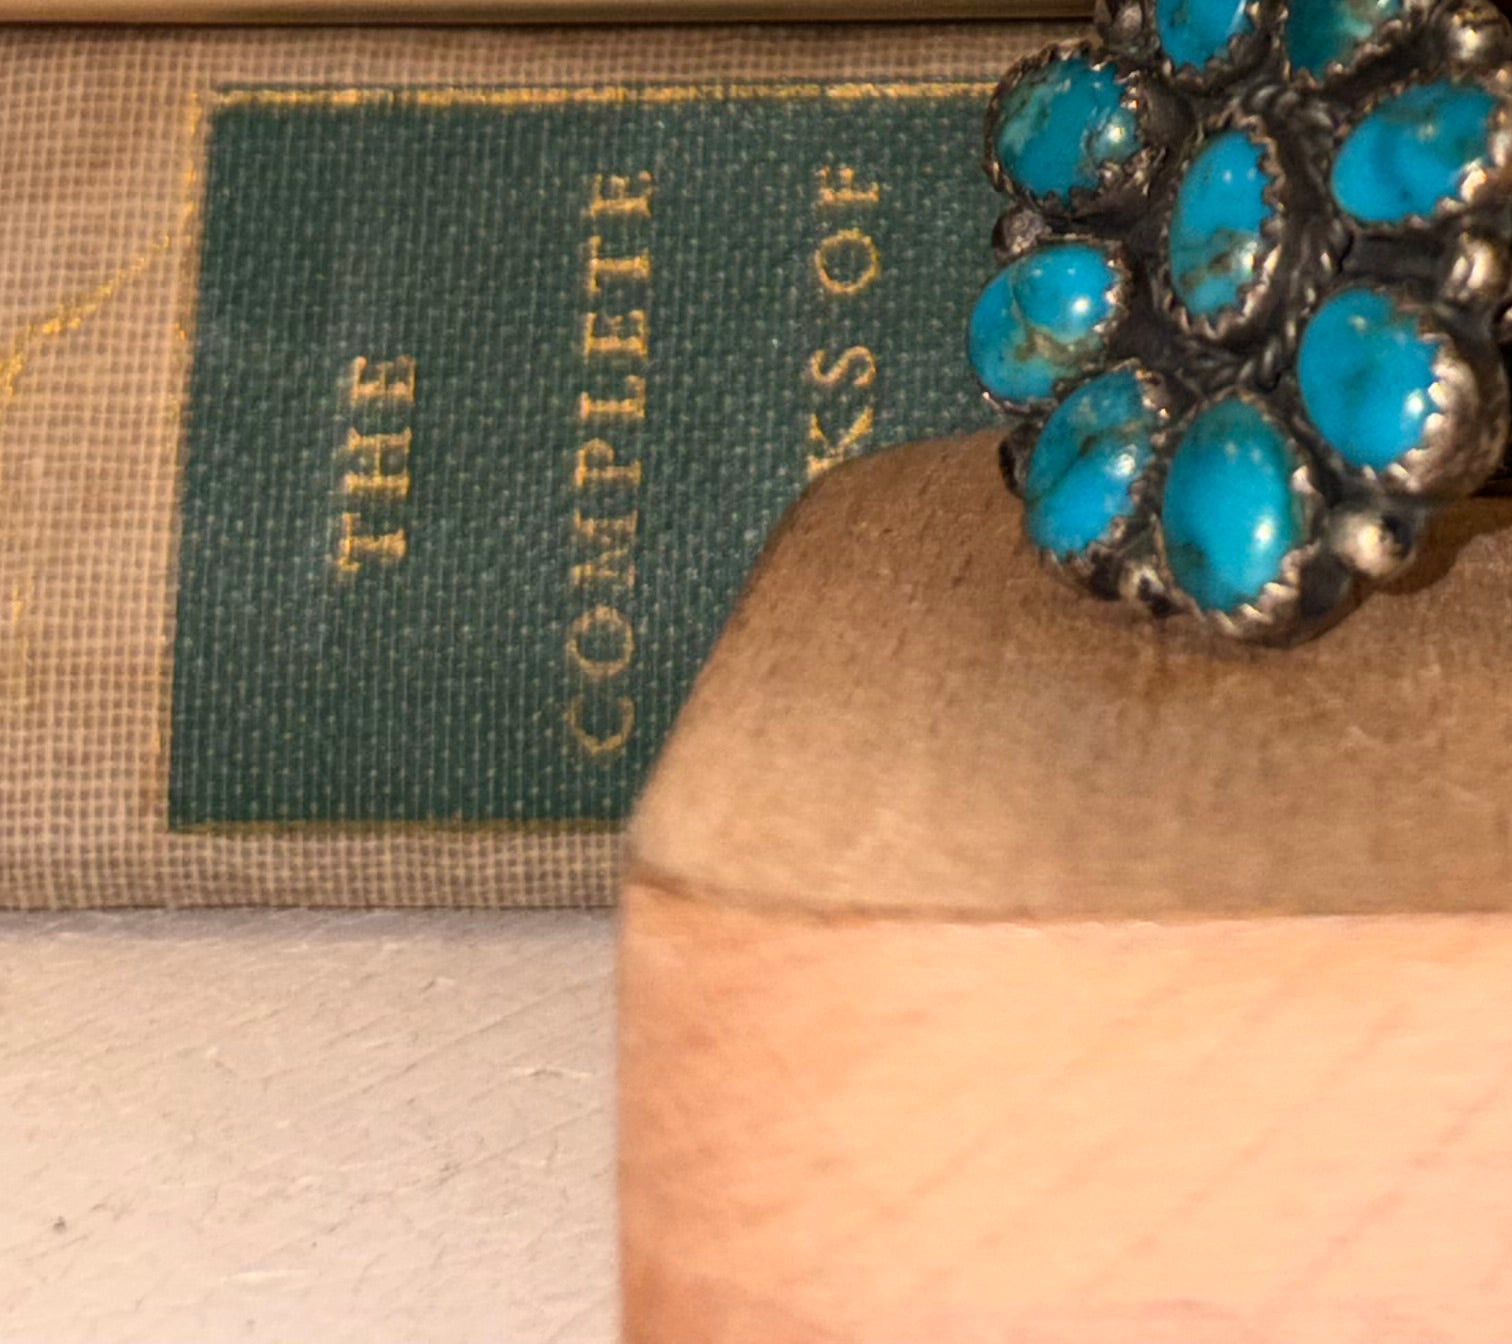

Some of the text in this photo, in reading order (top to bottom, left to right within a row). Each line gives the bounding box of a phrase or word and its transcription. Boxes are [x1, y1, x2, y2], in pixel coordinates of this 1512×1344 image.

[814, 165, 881, 296] OF
[334, 355, 417, 574] THE
[567, 170, 653, 755] COMPLETE
